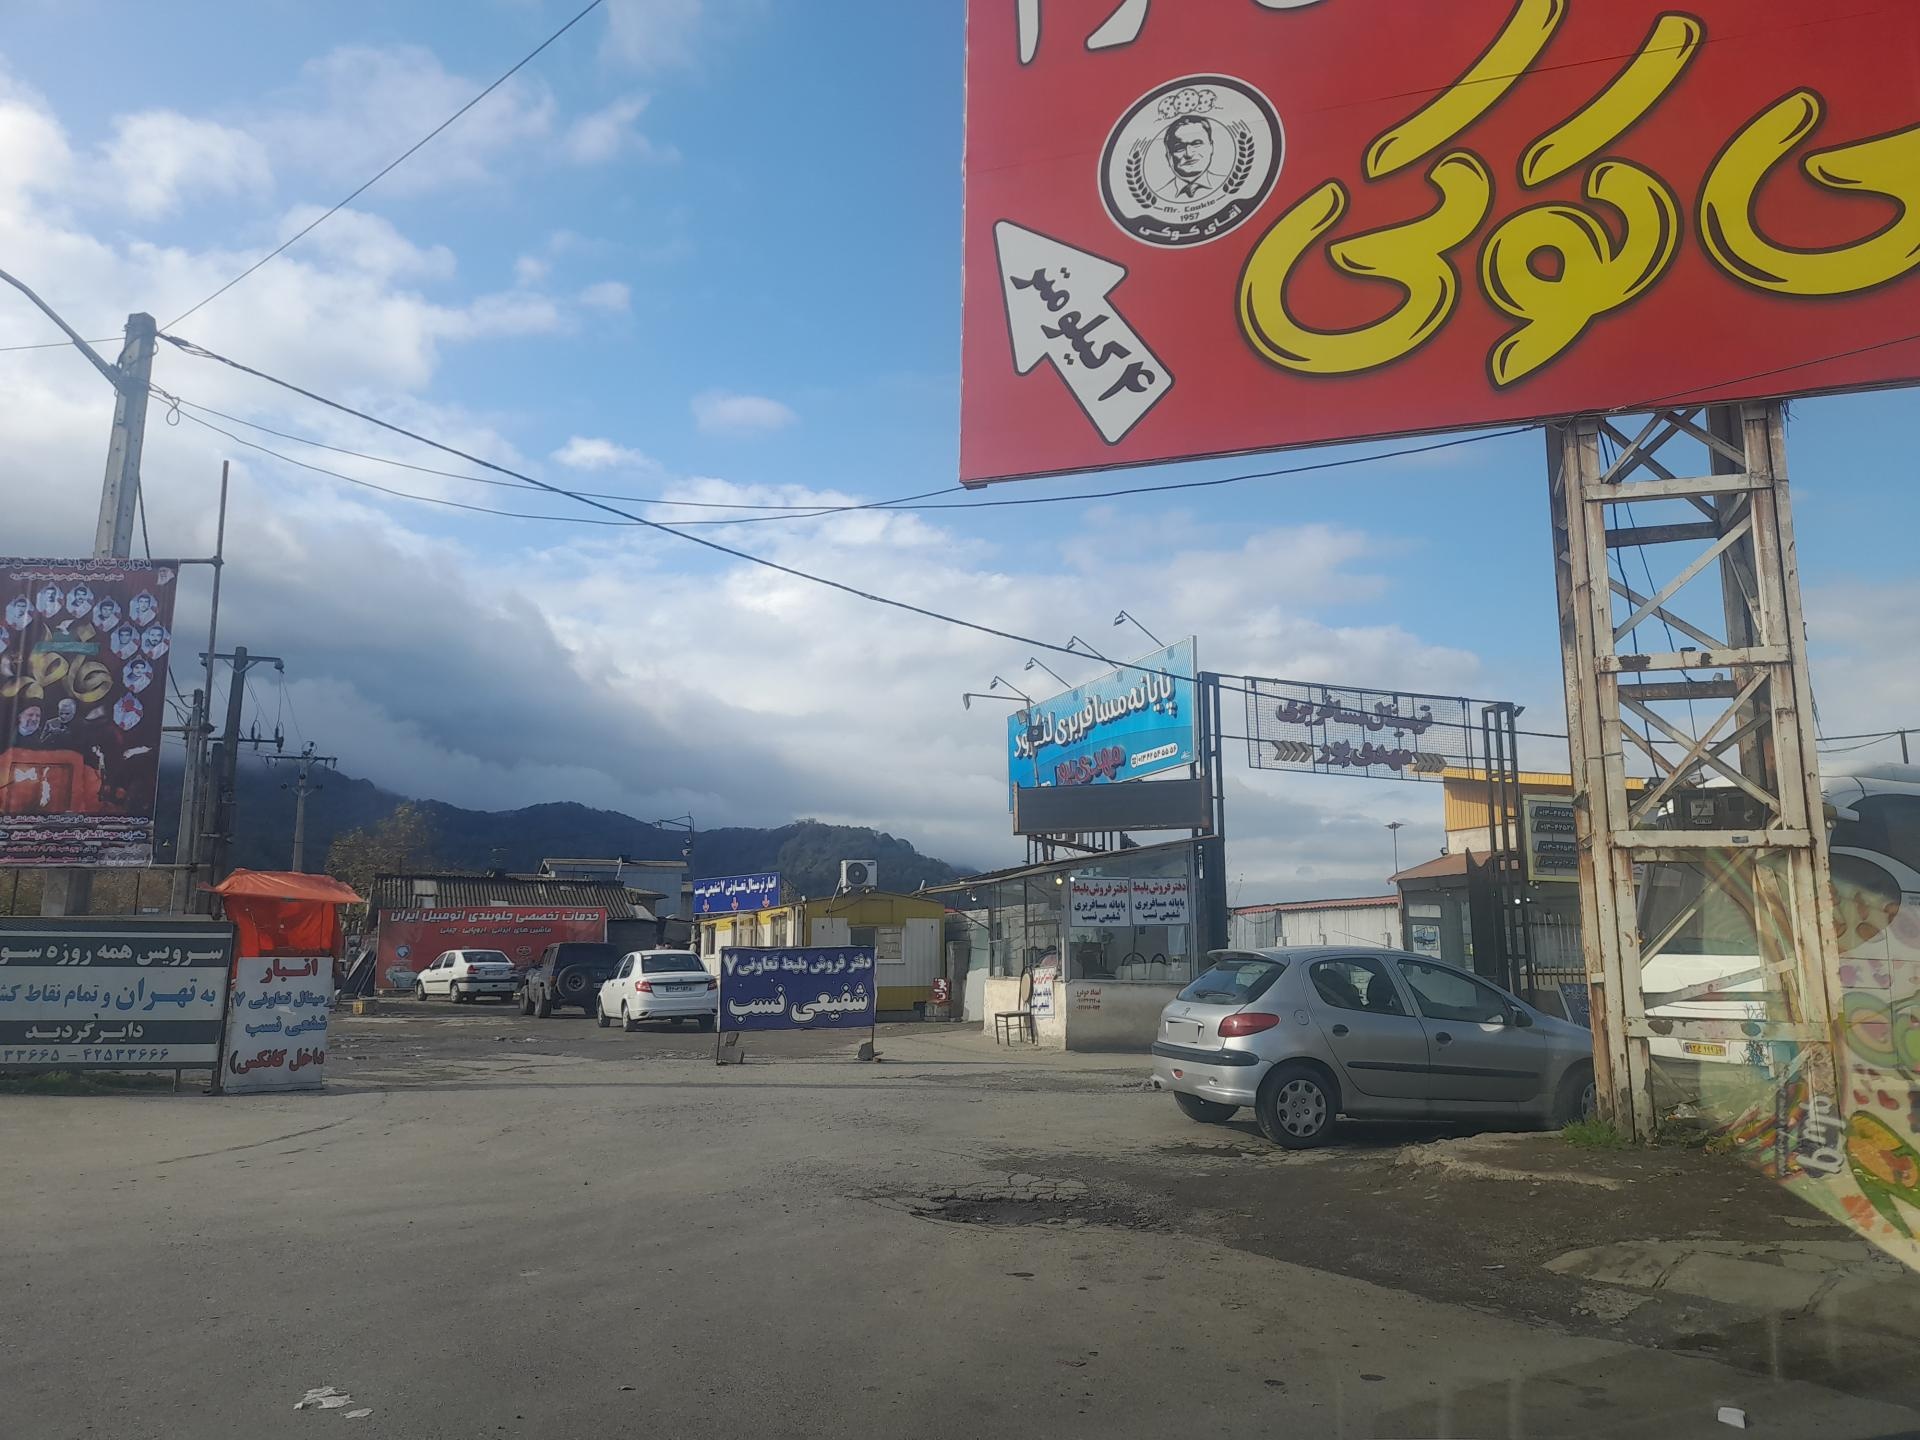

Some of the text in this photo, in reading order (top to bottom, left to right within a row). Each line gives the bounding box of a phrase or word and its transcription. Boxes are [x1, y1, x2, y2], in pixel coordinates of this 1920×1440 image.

[1163, 205, 1181, 214] Mr.
[1180, 212, 1200, 222] 1957
[1139, 226, 1200, 241] کوکی
[1010, 267, 1132, 370] کیلومتر
[1055, 694, 1127, 745] مسافربری
[725, 879, 746, 896] تعاونی
[1089, 882, 1111, 896] فروش
[1111, 882, 1127, 897] دفتر
[1149, 881, 1170, 895] فروش
[1170, 880, 1186, 894] دفتر
[1074, 898, 1126, 912] پایانه مسافربری
[1135, 898, 1167, 910] مسافربری
[390, 910, 599, 923] خدمات تخصصی جلوبندی اتومبیل ایران
[0, 943, 224, 967] سرویس همه روزه سو
[723, 952, 738, 976] ۷
[737, 952, 781, 976] تعاونی
[809, 953, 846, 975] فروش
[847, 952, 872, 974] دفتر
[260, 958, 319, 984] انبار
[0, 976, 217, 1011] به تهران و تمام نقاط کش
[248, 991, 293, 1009] تعاونی
[293, 990, 335, 1008] رمینال
[728, 982, 869, 1024] شفیعی نسب
[25, 1018, 144, 1044] دایر گردید
[245, 1016, 282, 1038] نسب
[0, 1048, 169, 1062] ۴۲۵۳۳۶۶۶ ۳۳۶۶۵
